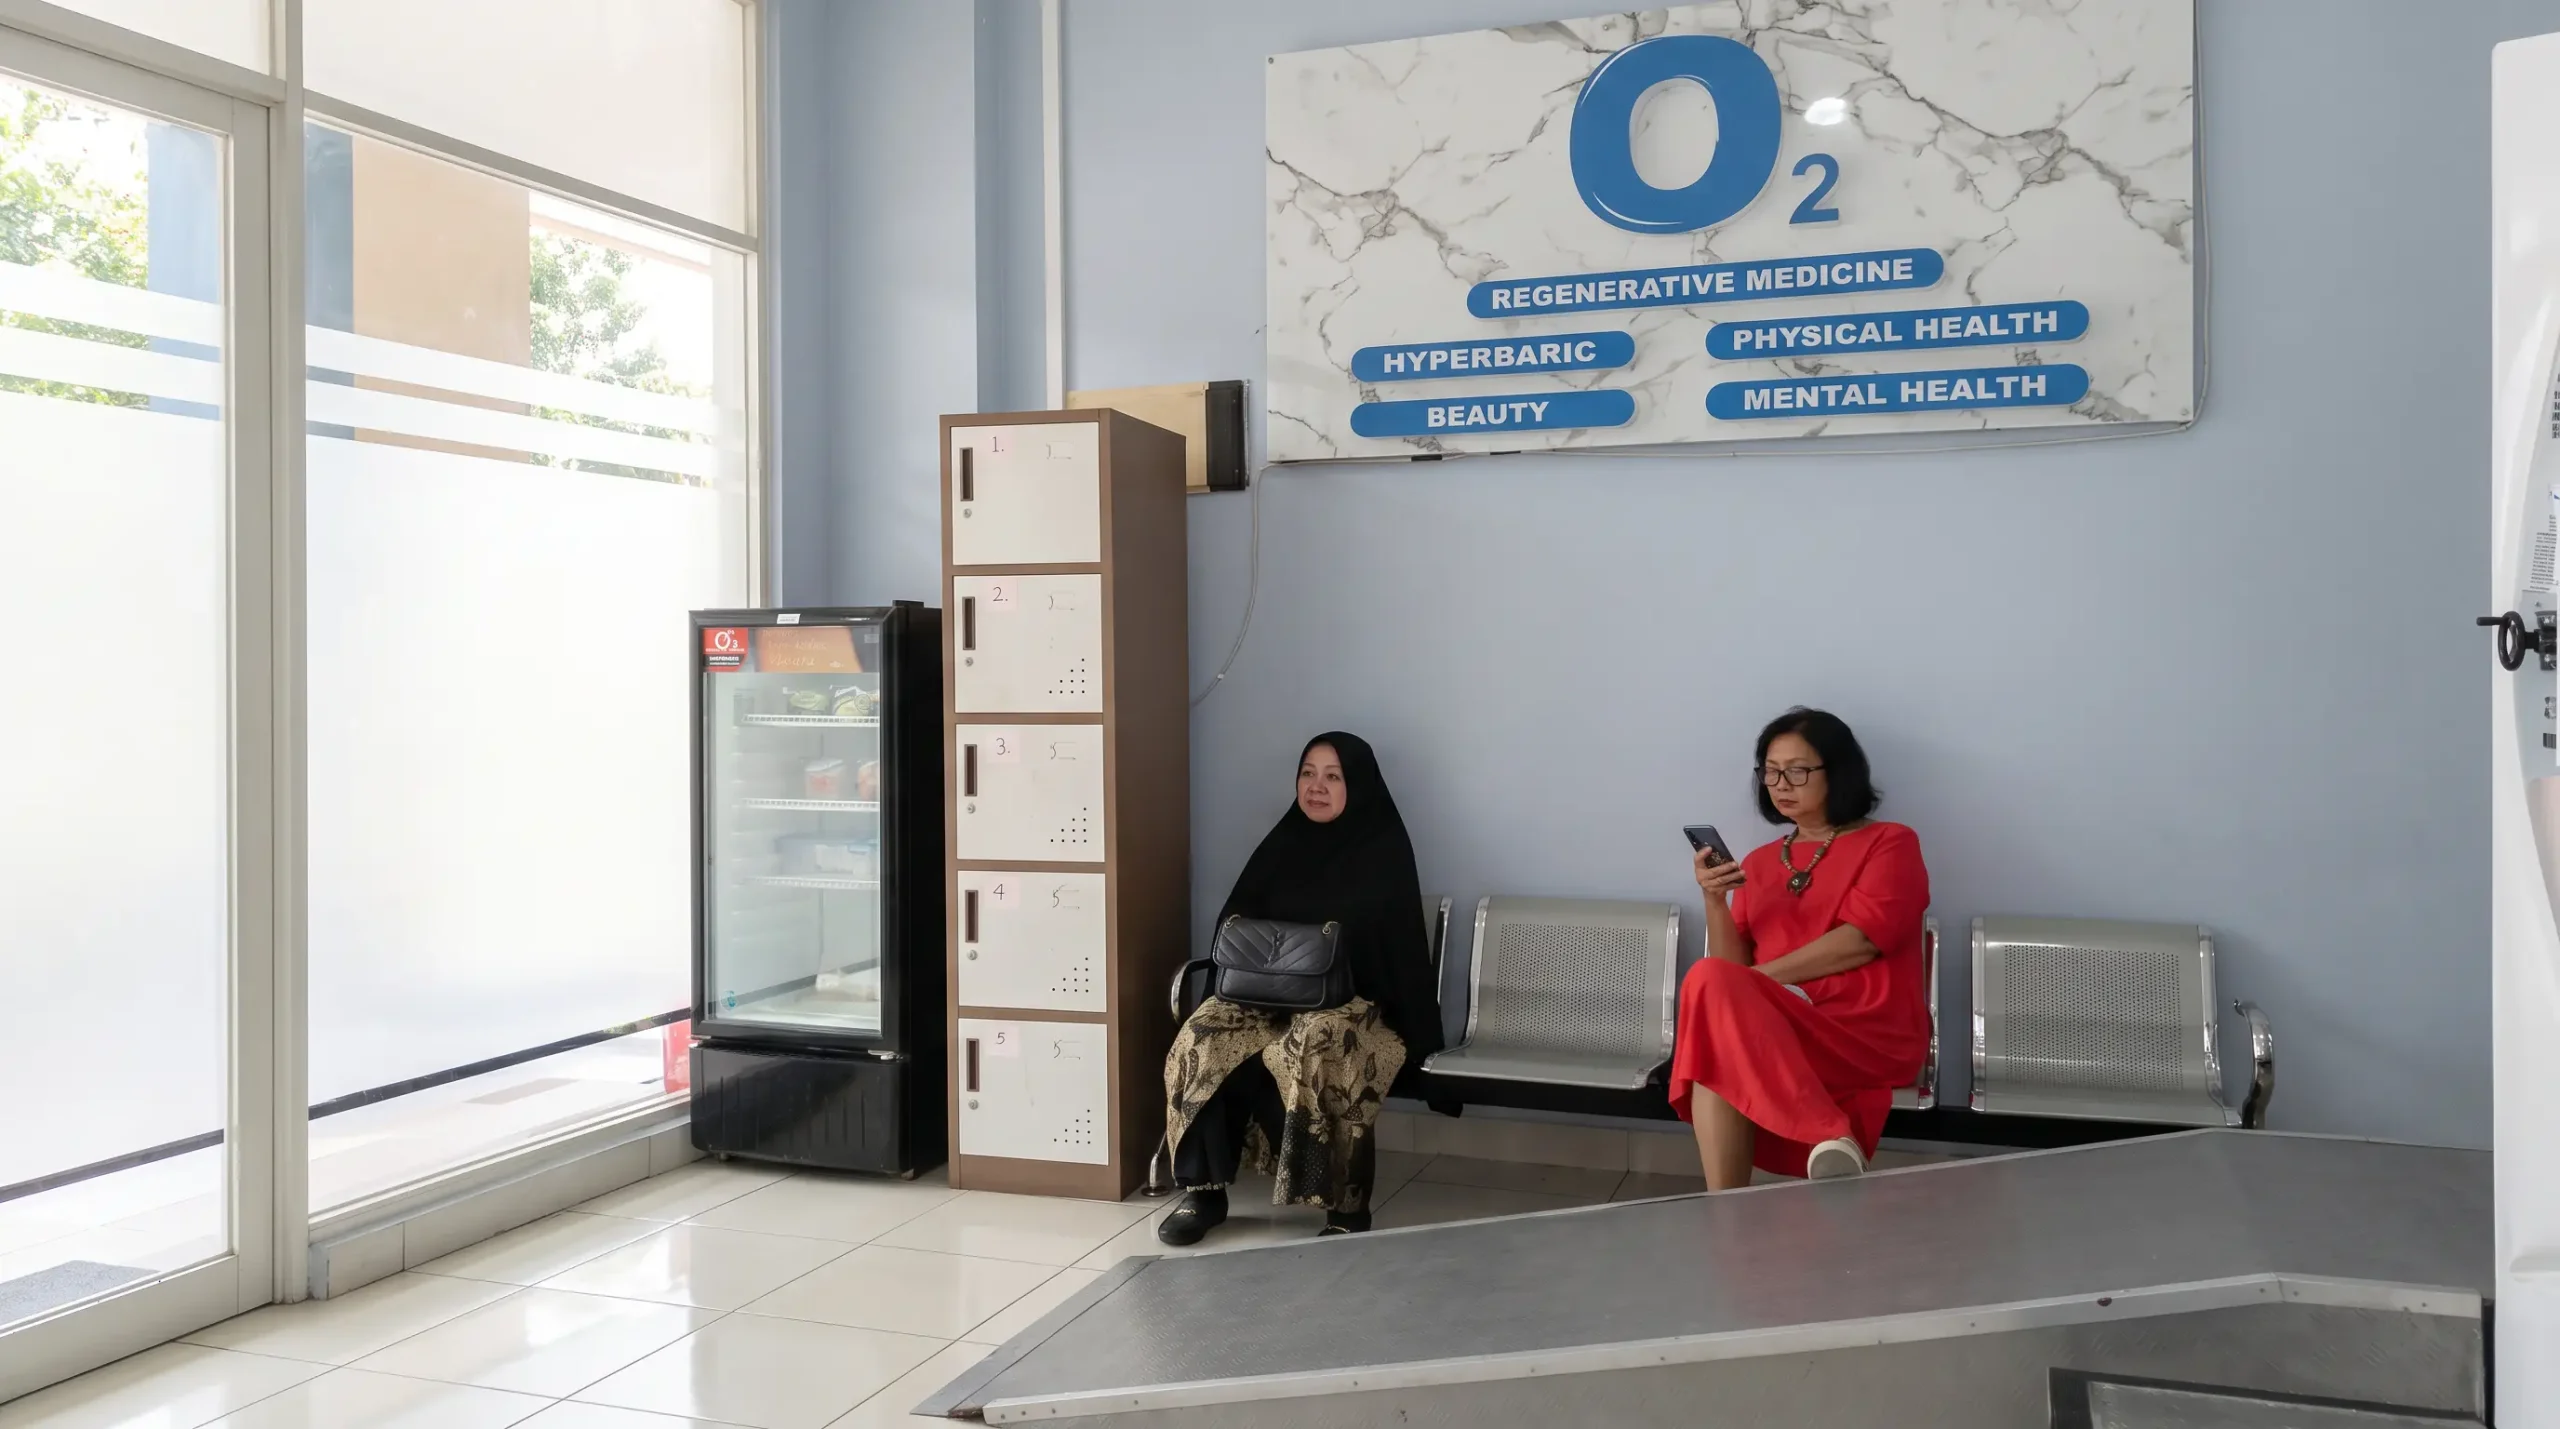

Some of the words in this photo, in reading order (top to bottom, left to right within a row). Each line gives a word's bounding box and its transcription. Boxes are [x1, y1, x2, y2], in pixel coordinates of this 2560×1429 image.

[1491, 271, 1735, 311] REGENERATIVE
[1746, 257, 1914, 292] MEDICINE
[1733, 320, 1903, 351] PHYSICAL
[1914, 310, 2058, 341] HEALTH
[1383, 340, 1597, 374] HYPERBARIC
[1743, 382, 1888, 411] MENTAL
[1900, 374, 2047, 404] HEALTH
[1427, 401, 1549, 428] BEAUTY
[992, 883, 1005, 901] 4
[995, 1032, 1006, 1045] 5
